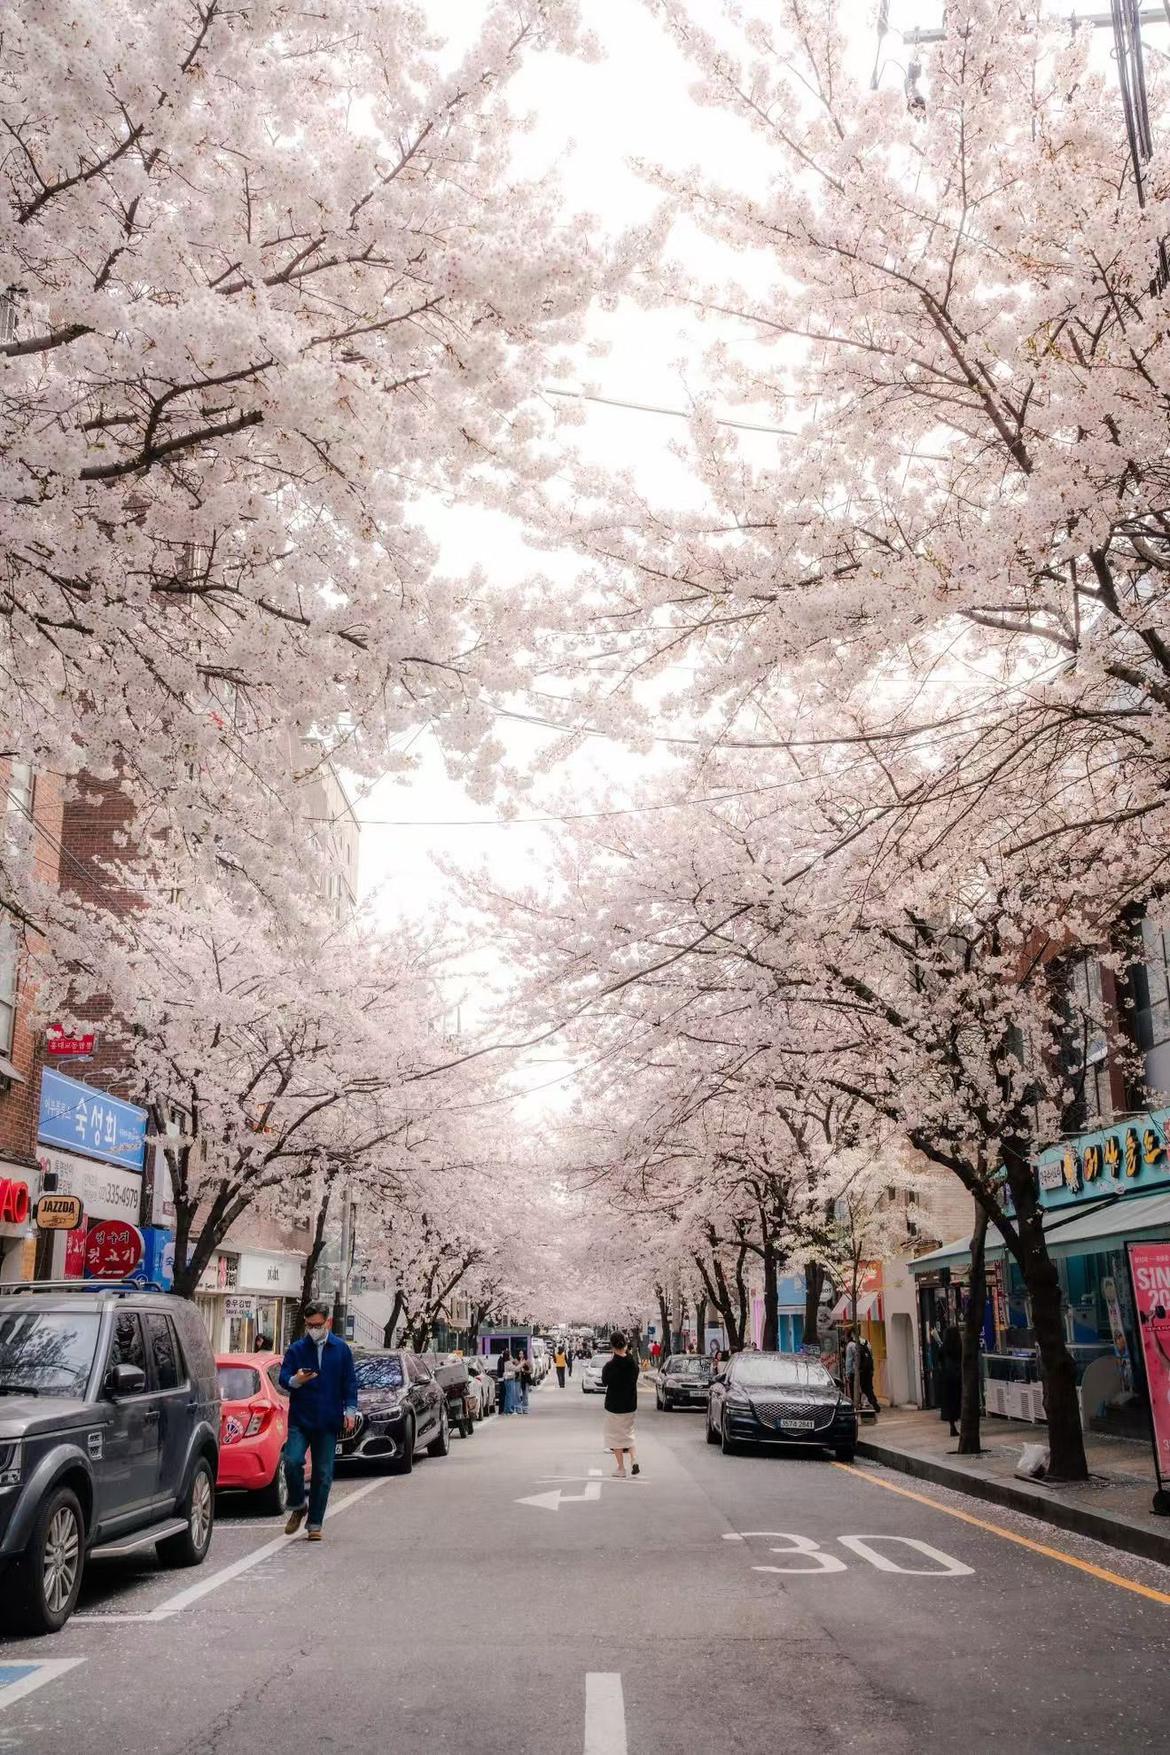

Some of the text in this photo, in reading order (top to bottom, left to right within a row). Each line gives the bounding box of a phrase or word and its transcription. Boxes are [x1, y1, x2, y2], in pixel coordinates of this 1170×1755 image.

[75, 1097, 117, 1146] 숙성회
[41, 1200, 75, 1214] JAZZDA
[721, 1532, 976, 1576] 30
